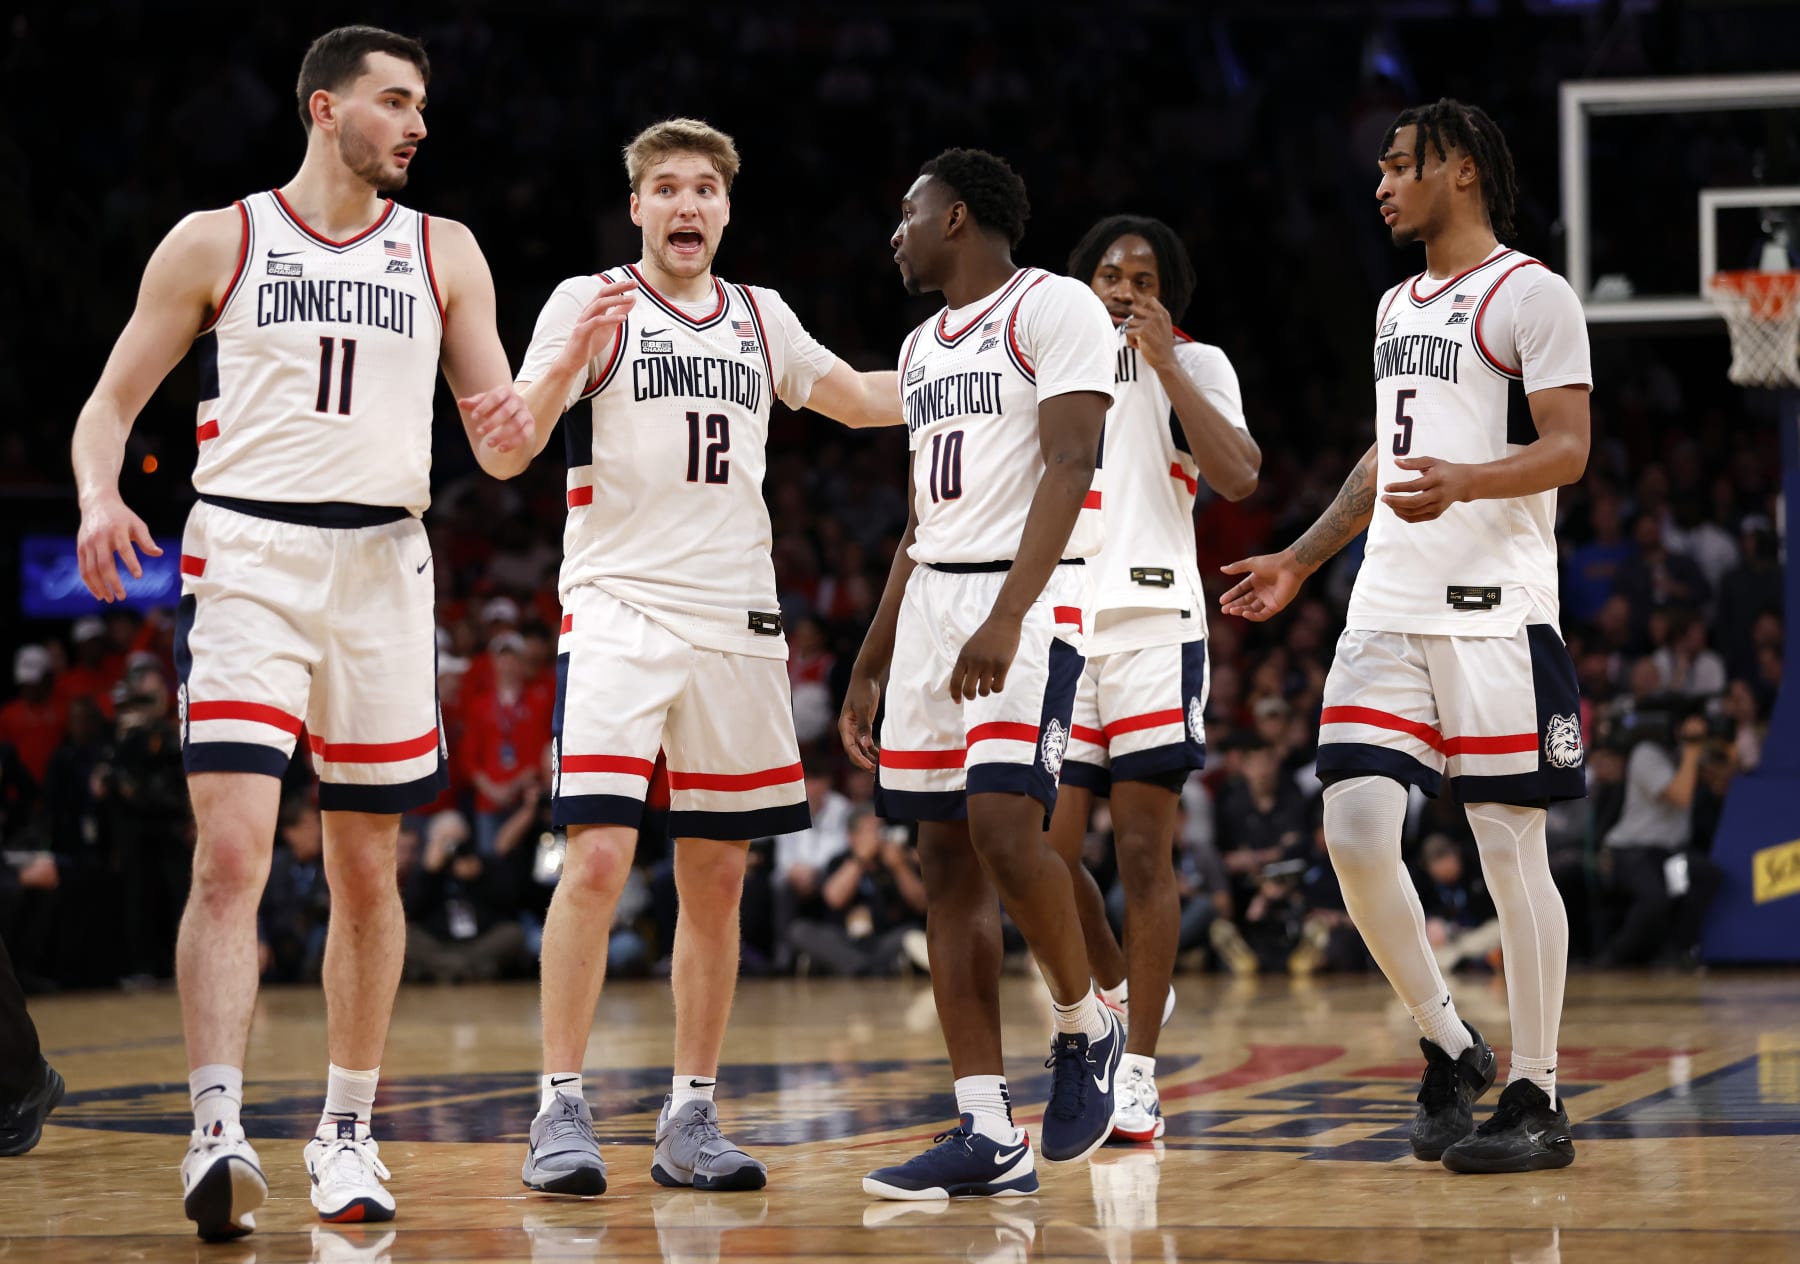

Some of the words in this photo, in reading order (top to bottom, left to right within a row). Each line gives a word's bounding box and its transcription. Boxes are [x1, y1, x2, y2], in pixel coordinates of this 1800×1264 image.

[386, 265, 415, 273] EAST
[257, 280, 417, 339] CONNECTICUT
[315, 336, 357, 415] 11
[632, 356, 761, 414] CONNECTICUT
[906, 371, 1002, 438] CONNECTICUT
[685, 411, 730, 485] 12
[1392, 389, 1417, 457] 5
[930, 430, 964, 504] 10
[1486, 592, 1497, 600] 46
